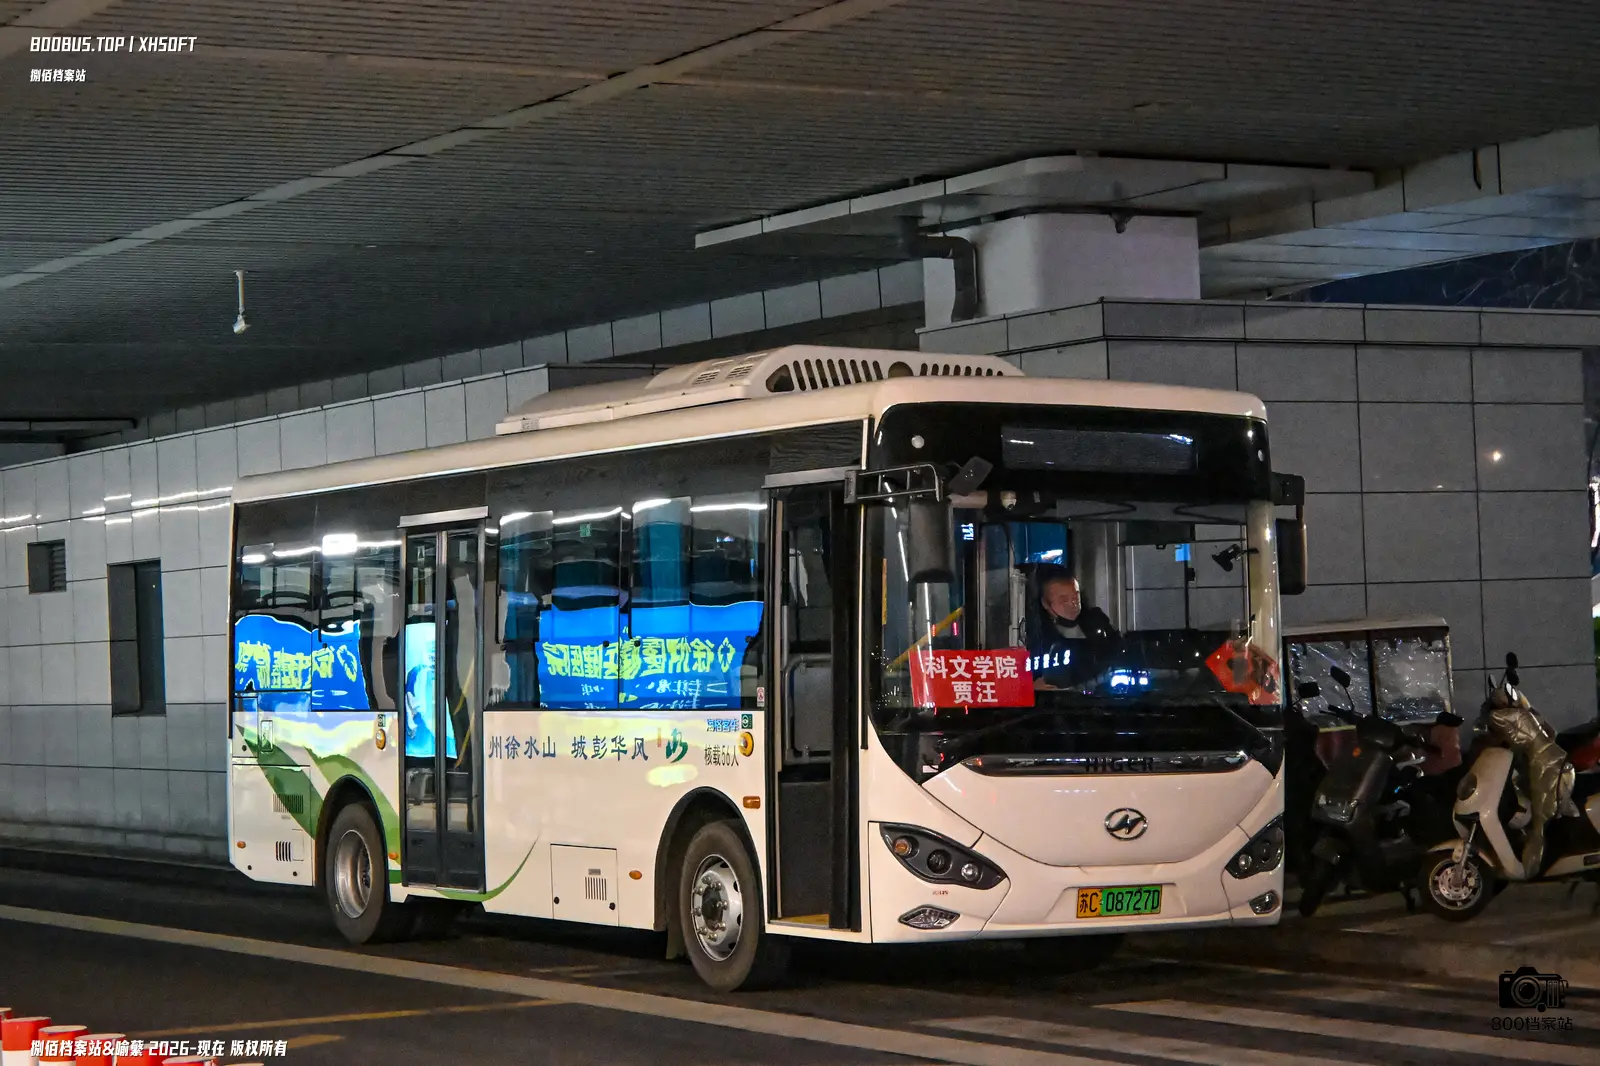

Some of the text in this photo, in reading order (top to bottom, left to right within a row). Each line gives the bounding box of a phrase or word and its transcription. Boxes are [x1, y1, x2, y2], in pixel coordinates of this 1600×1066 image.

[924, 655, 1019, 679] 科文学院
[951, 681, 998, 704] 贾汪
[704, 744, 740, 767] 核载56人
